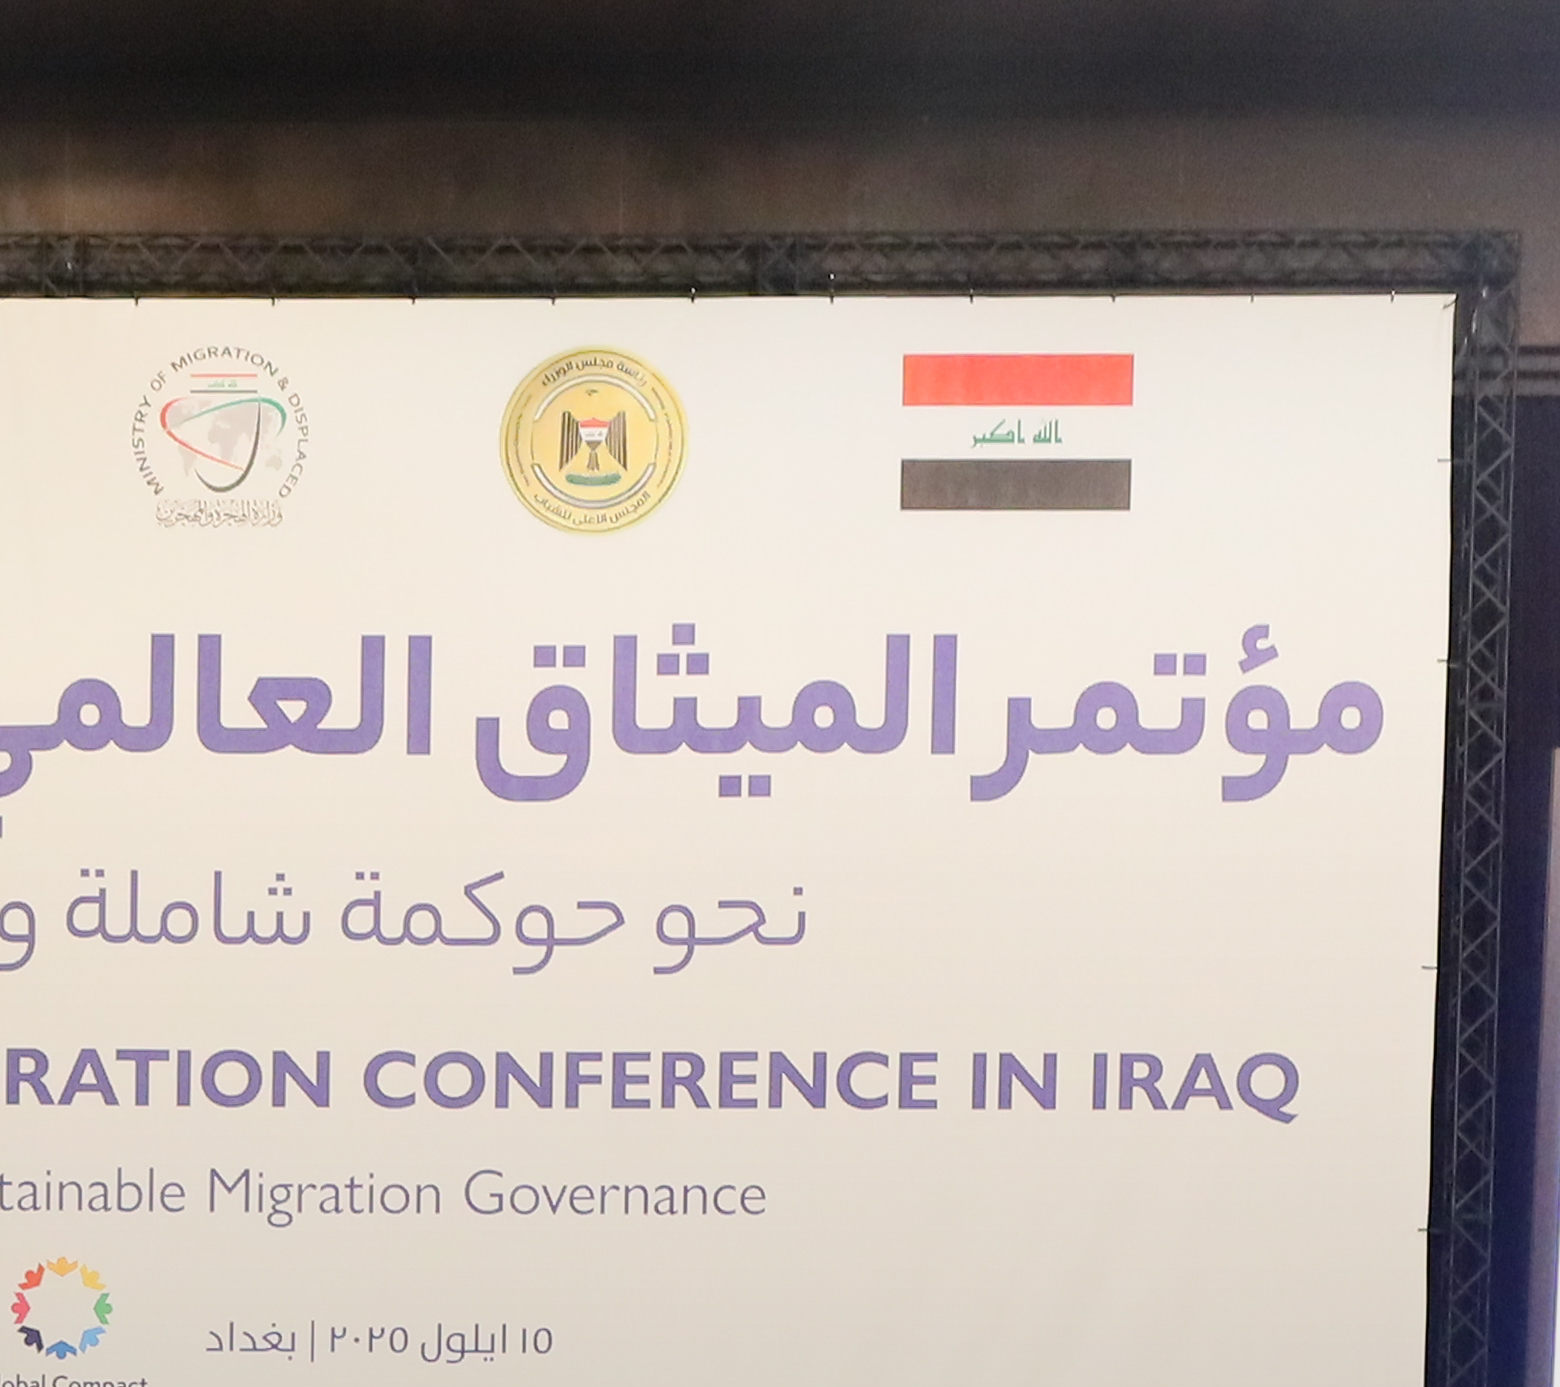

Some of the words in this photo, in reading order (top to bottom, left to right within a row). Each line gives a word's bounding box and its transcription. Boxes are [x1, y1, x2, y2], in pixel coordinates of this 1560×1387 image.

[150, 371, 167, 392] OF
[170, 346, 279, 377] MIGRATION
[277, 377, 289, 391] &
[575, 356, 614, 371] مجلس
[132, 395, 165, 496] MINISTRY
[278, 393, 309, 498] DISPLACED
[475, 623, 957, 802] الميثاق
[970, 624, 1383, 802] مؤتمر
[67, 869, 310, 945] شاملة
[341, 871, 625, 975] حوكمة
[653, 887, 805, 974] نحو
[364, 1051, 938, 1109] CONFERENCE
[972, 1053, 1057, 1110] IN
[1092, 1053, 1299, 1124] IRAQ
[210, 1168, 440, 1227] Migration
[465, 1170, 765, 1215] Governance
[206, 1322, 295, 1360] بغداد
[331, 1327, 408, 1353] ٢٠٢٥
[421, 1323, 506, 1363] ايلول
[522, 1328, 552, 1353] ١٥
